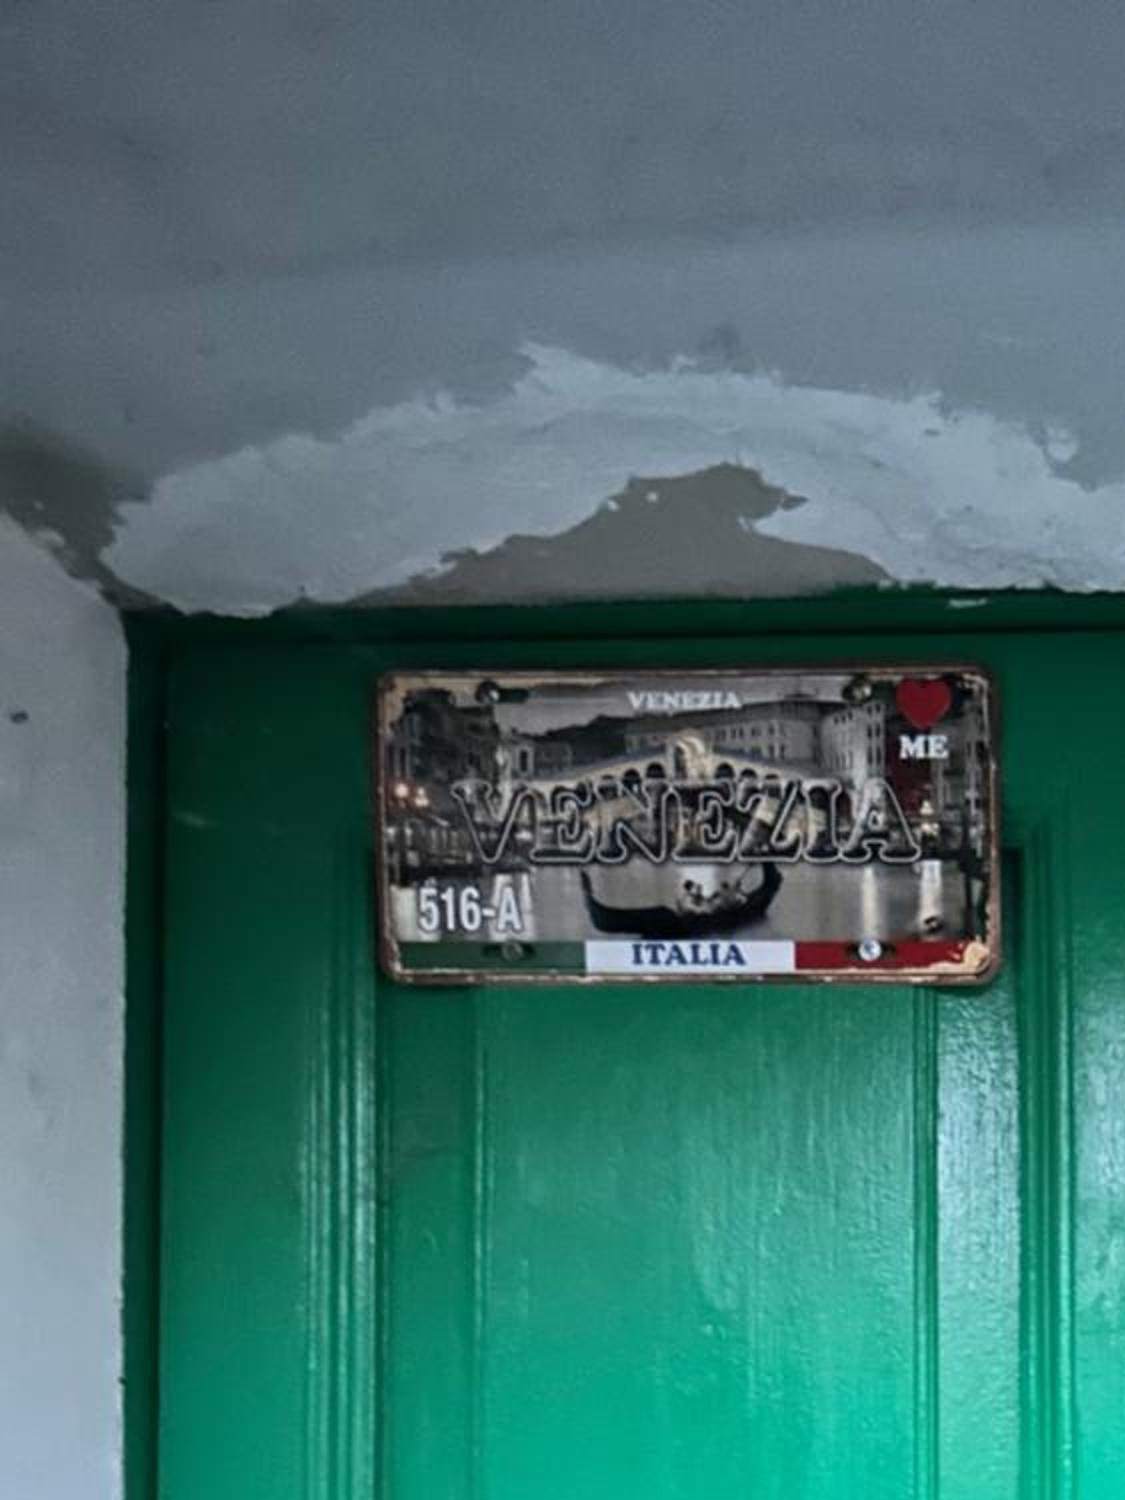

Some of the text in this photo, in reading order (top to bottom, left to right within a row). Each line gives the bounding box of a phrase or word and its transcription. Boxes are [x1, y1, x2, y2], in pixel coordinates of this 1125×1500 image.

[627, 691, 742, 710] VENEZIA
[899, 735, 949, 760] ME
[450, 779, 923, 863] VENEZIA
[418, 886, 522, 932] 516-A
[631, 943, 747, 967] ITALIA
